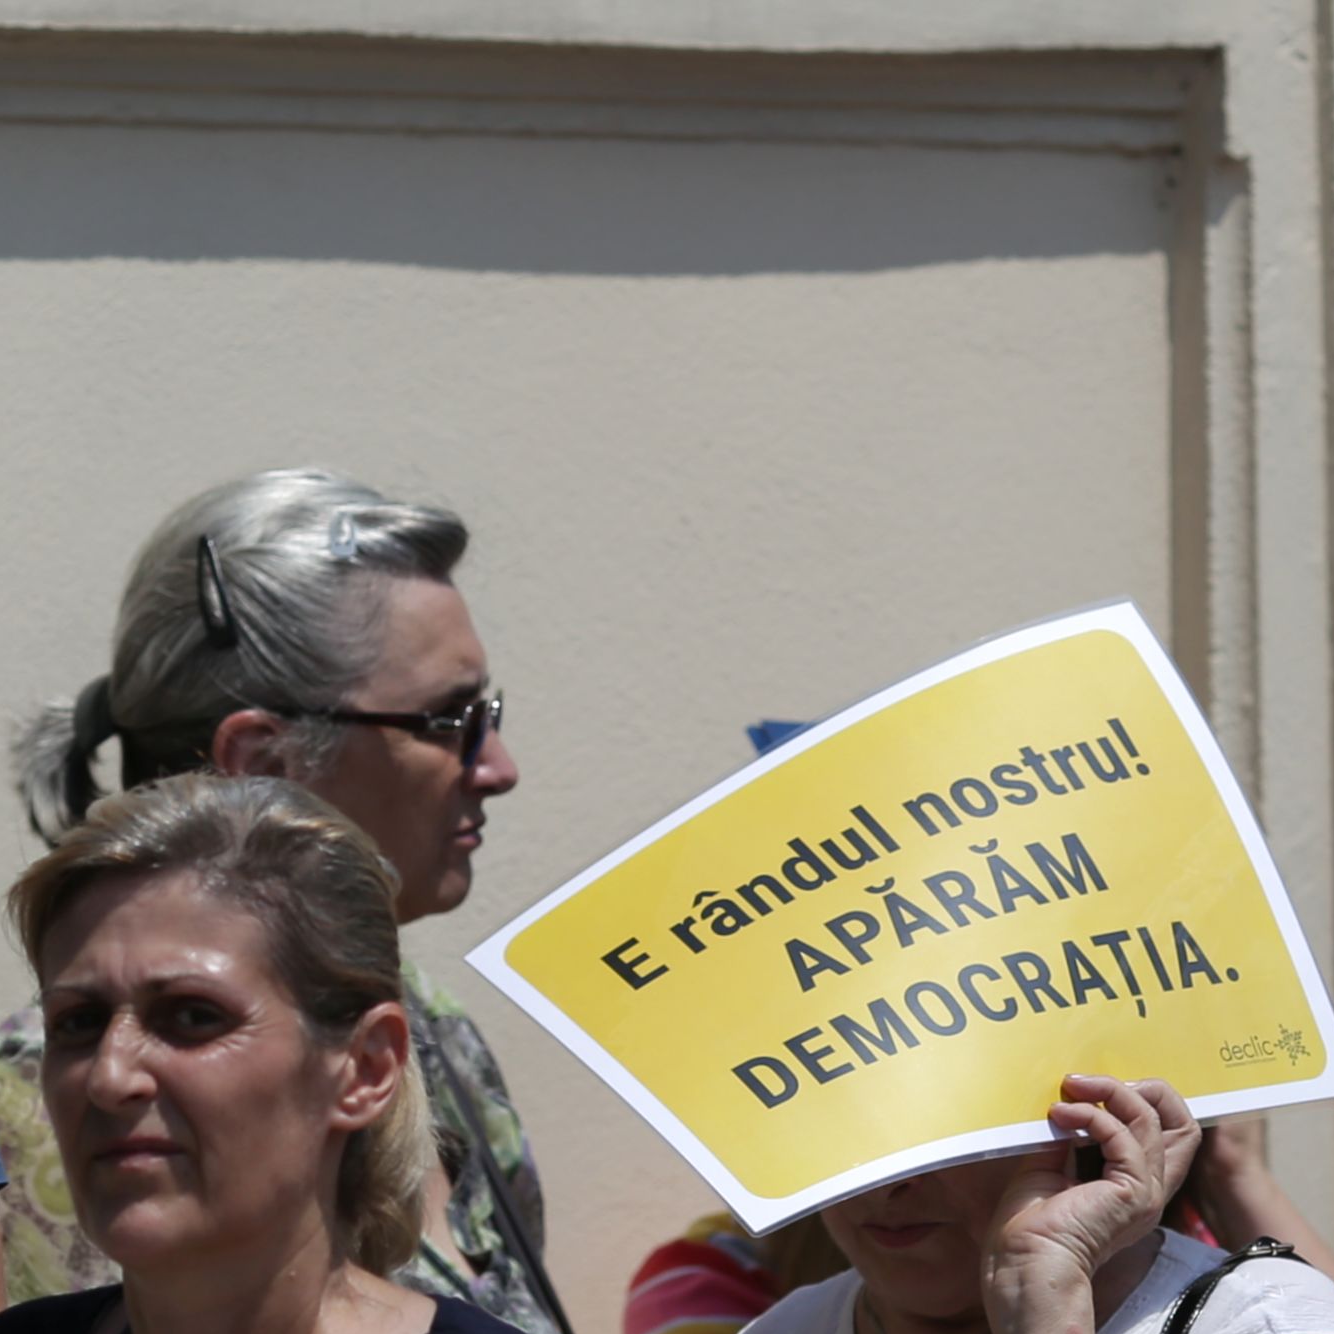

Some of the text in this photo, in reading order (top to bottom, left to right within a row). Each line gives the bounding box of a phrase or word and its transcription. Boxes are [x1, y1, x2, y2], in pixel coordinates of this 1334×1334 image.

[601, 717, 1151, 990] E rândul nostru!
[785, 832, 1109, 993] APĂRĂM
[731, 920, 1241, 1108] DEMOCRAȚIA.
[1219, 1036, 1274, 1062] declic
